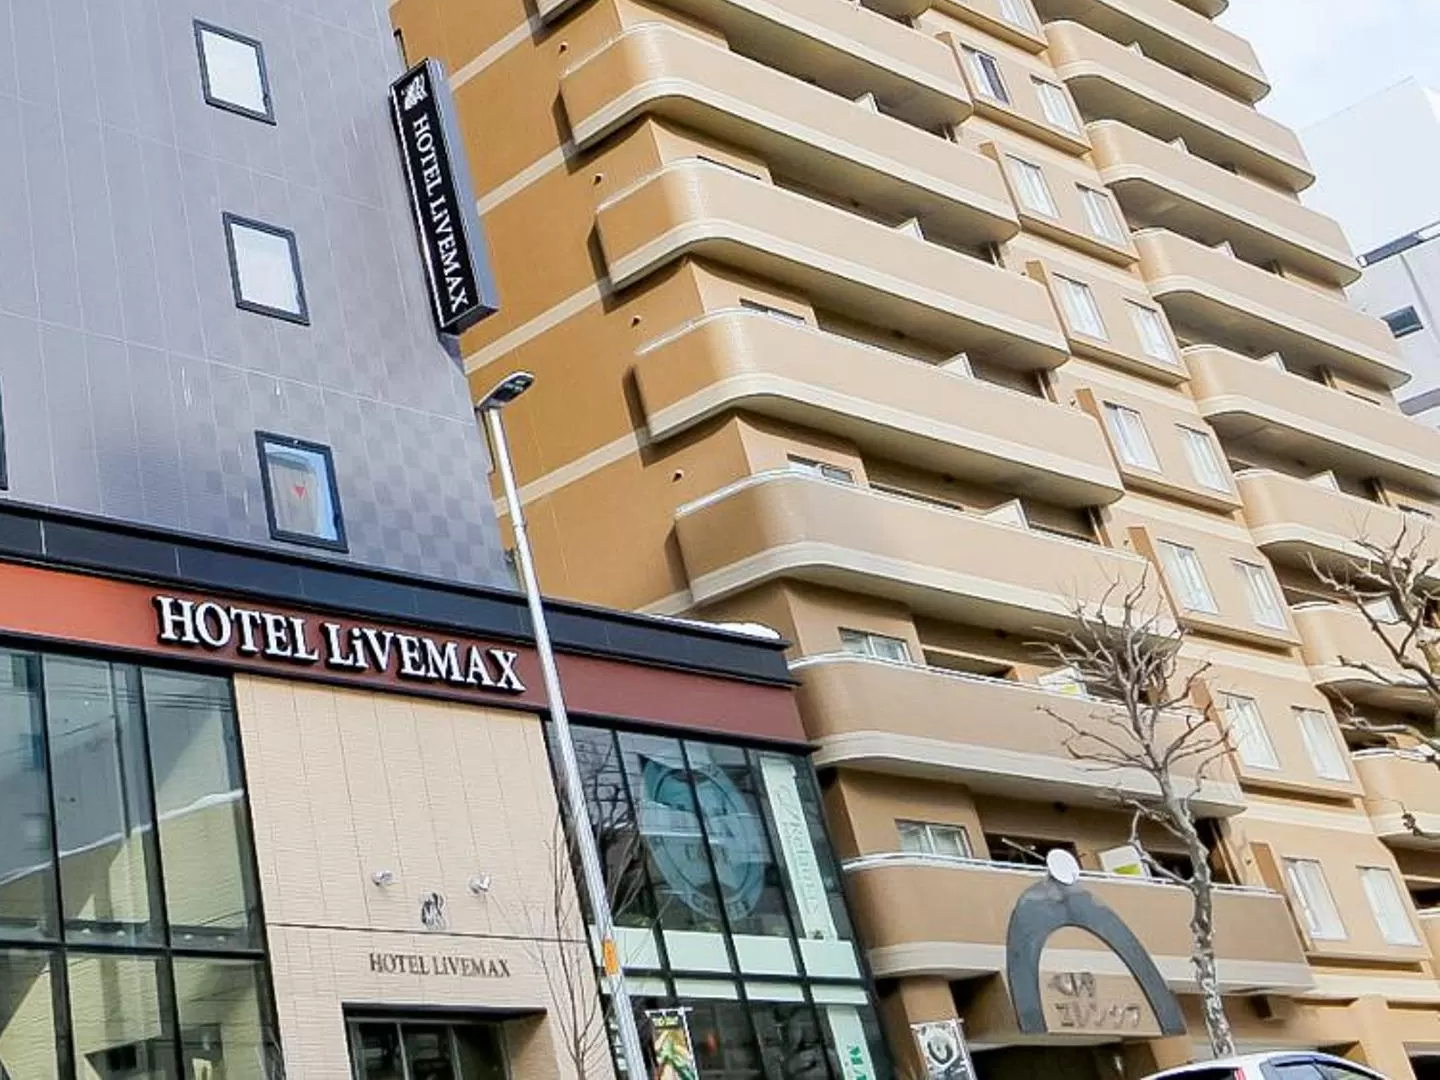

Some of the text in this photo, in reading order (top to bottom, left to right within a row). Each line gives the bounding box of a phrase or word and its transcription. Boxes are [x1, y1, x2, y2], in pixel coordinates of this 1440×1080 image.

[412, 113, 442, 197] HOTEL
[155, 594, 320, 662] HOTEL
[369, 952, 430, 975] HOTEL
